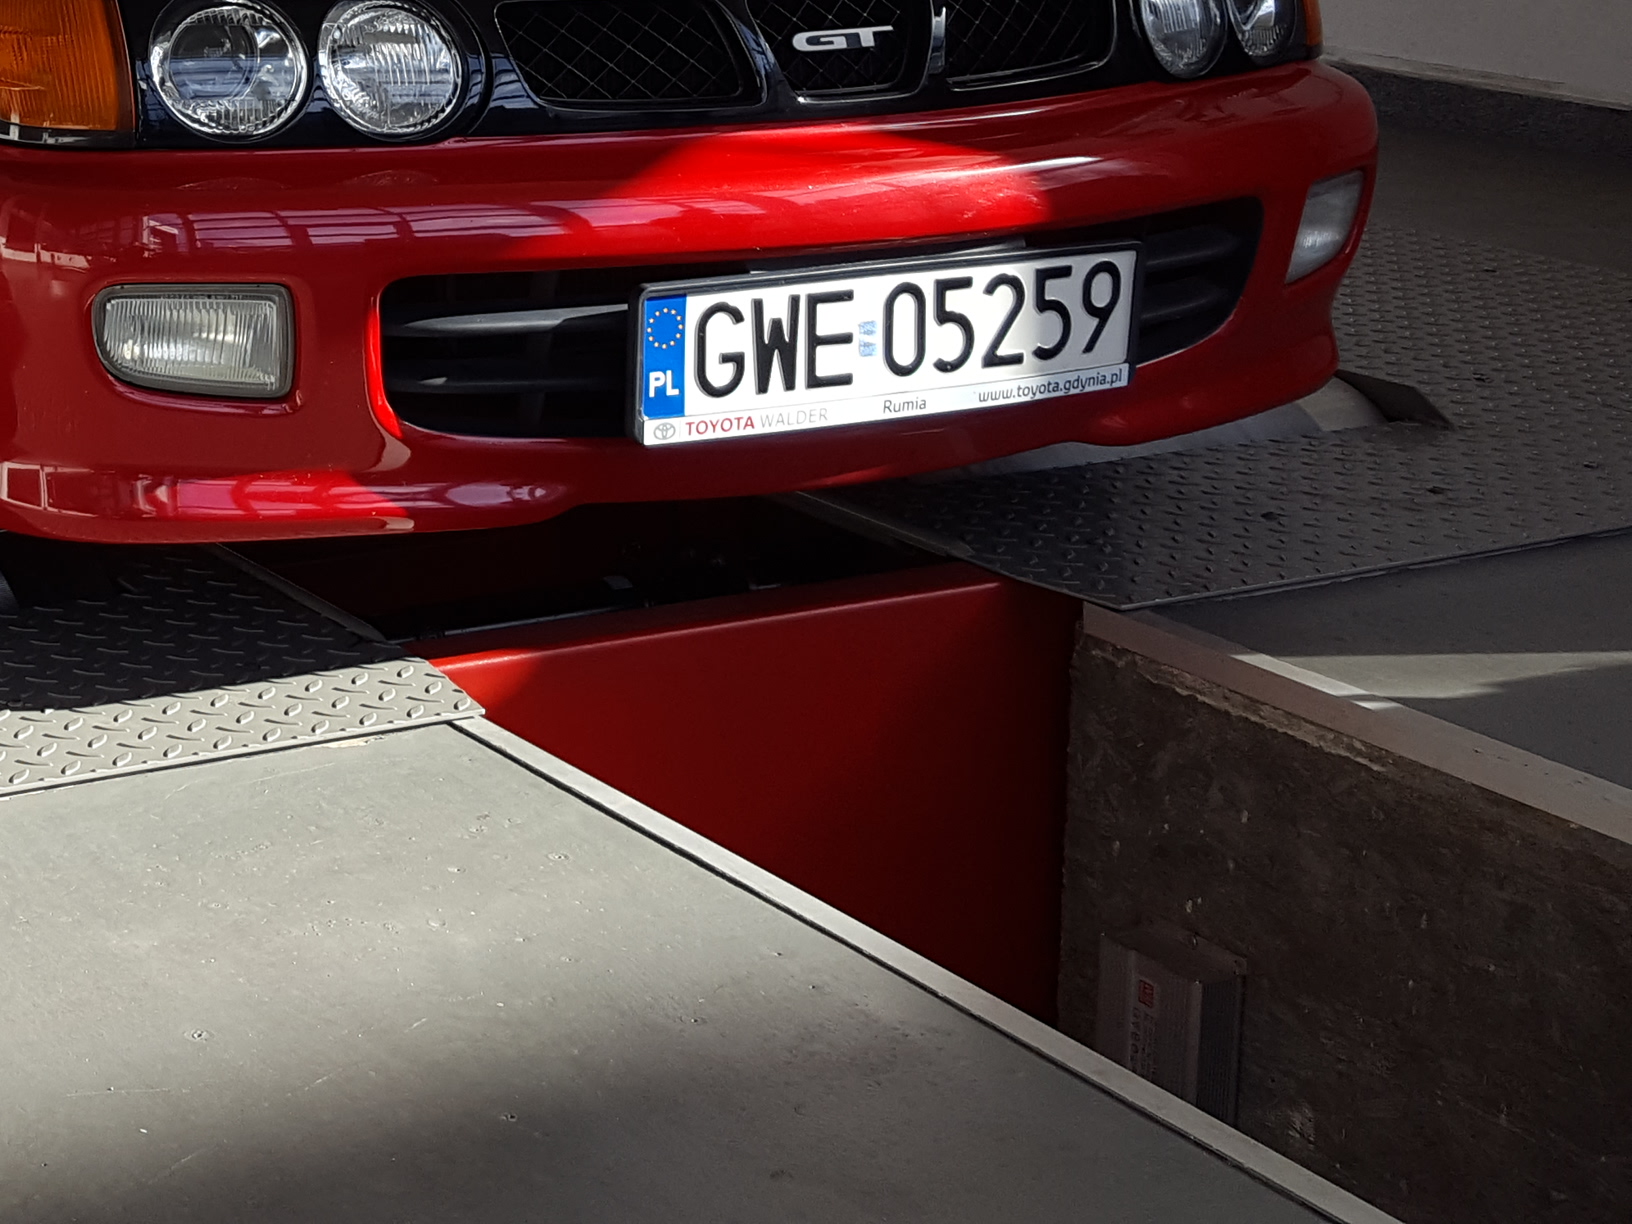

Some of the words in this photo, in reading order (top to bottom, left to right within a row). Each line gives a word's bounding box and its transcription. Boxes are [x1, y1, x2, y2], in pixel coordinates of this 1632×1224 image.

[792, 25, 894, 51] GT
[694, 289, 855, 398] GWE
[882, 259, 1122, 377] 05259
[648, 369, 680, 398] PL
[685, 416, 755, 436] TOYOTA
[760, 407, 829, 429] WALDER
[882, 397, 927, 414] Rumia
[978, 368, 1123, 403] www.toyota.gdynia.pl
